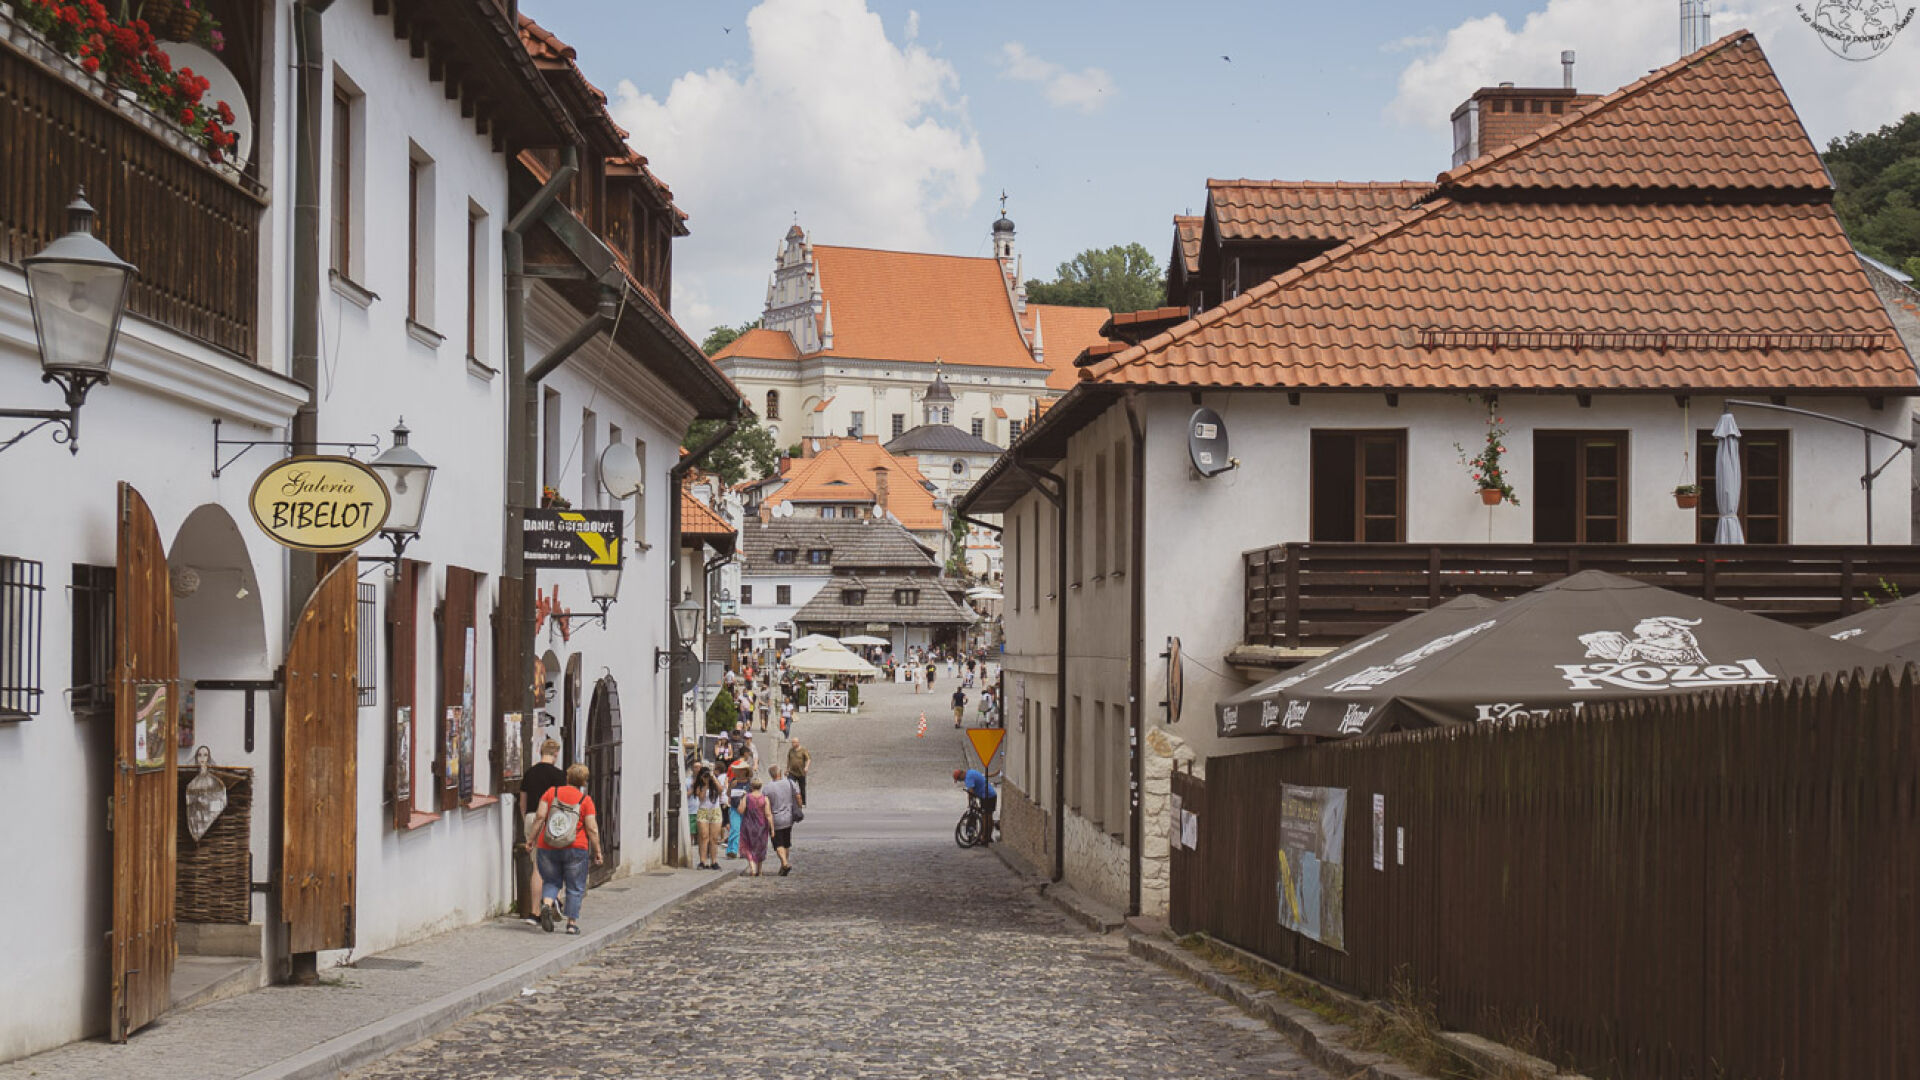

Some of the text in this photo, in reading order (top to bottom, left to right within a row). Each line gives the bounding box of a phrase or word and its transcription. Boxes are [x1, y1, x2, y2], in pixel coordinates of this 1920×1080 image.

[281, 470, 357, 496] Galeria
[272, 501, 374, 529] BIBELOT
[542, 538, 571, 549] Pizza
[1554, 658, 1778, 691] Kozel
